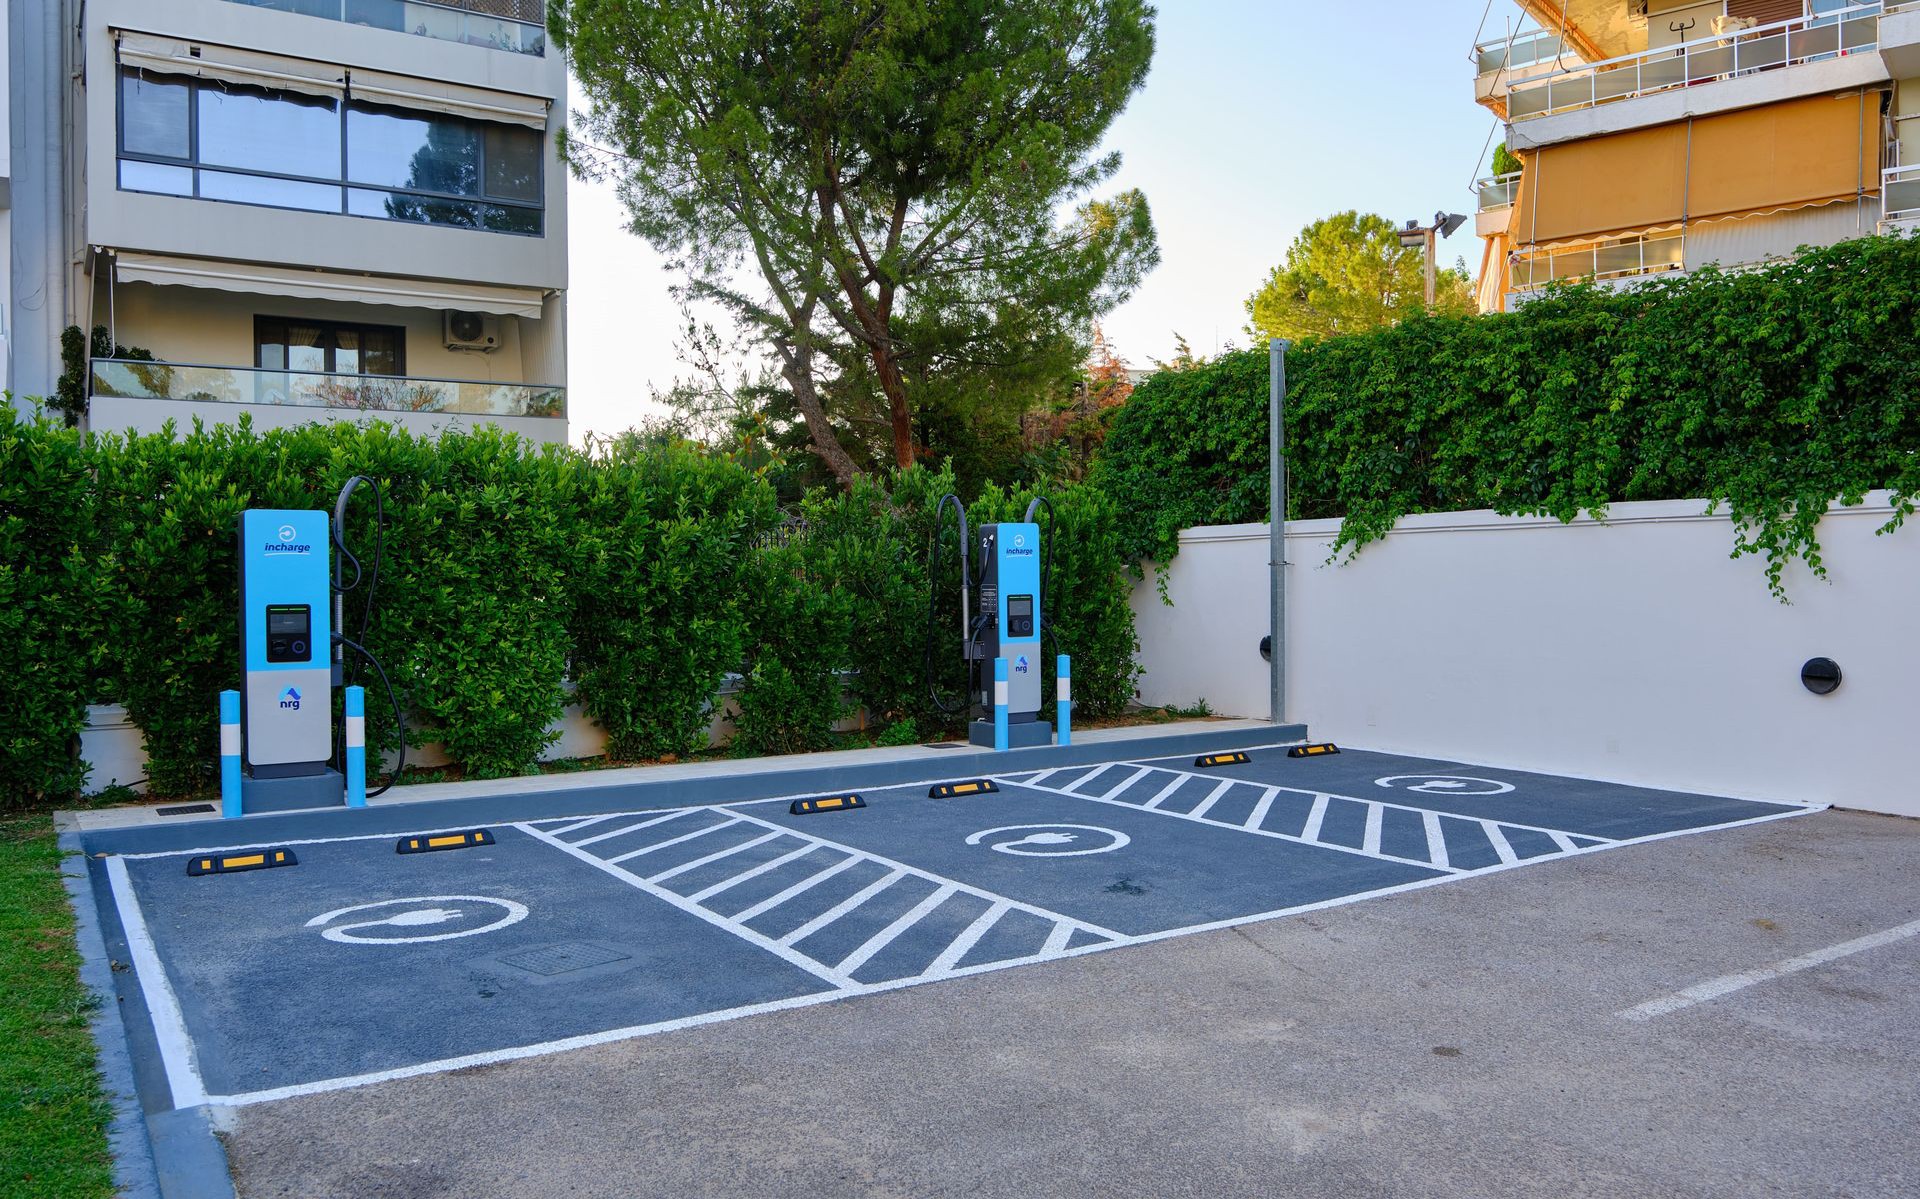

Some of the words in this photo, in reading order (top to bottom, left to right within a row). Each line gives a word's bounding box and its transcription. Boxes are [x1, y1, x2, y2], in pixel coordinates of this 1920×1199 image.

[264, 543, 311, 553] incharge
[983, 538, 988, 548] 2
[280, 700, 300, 711] nrg
